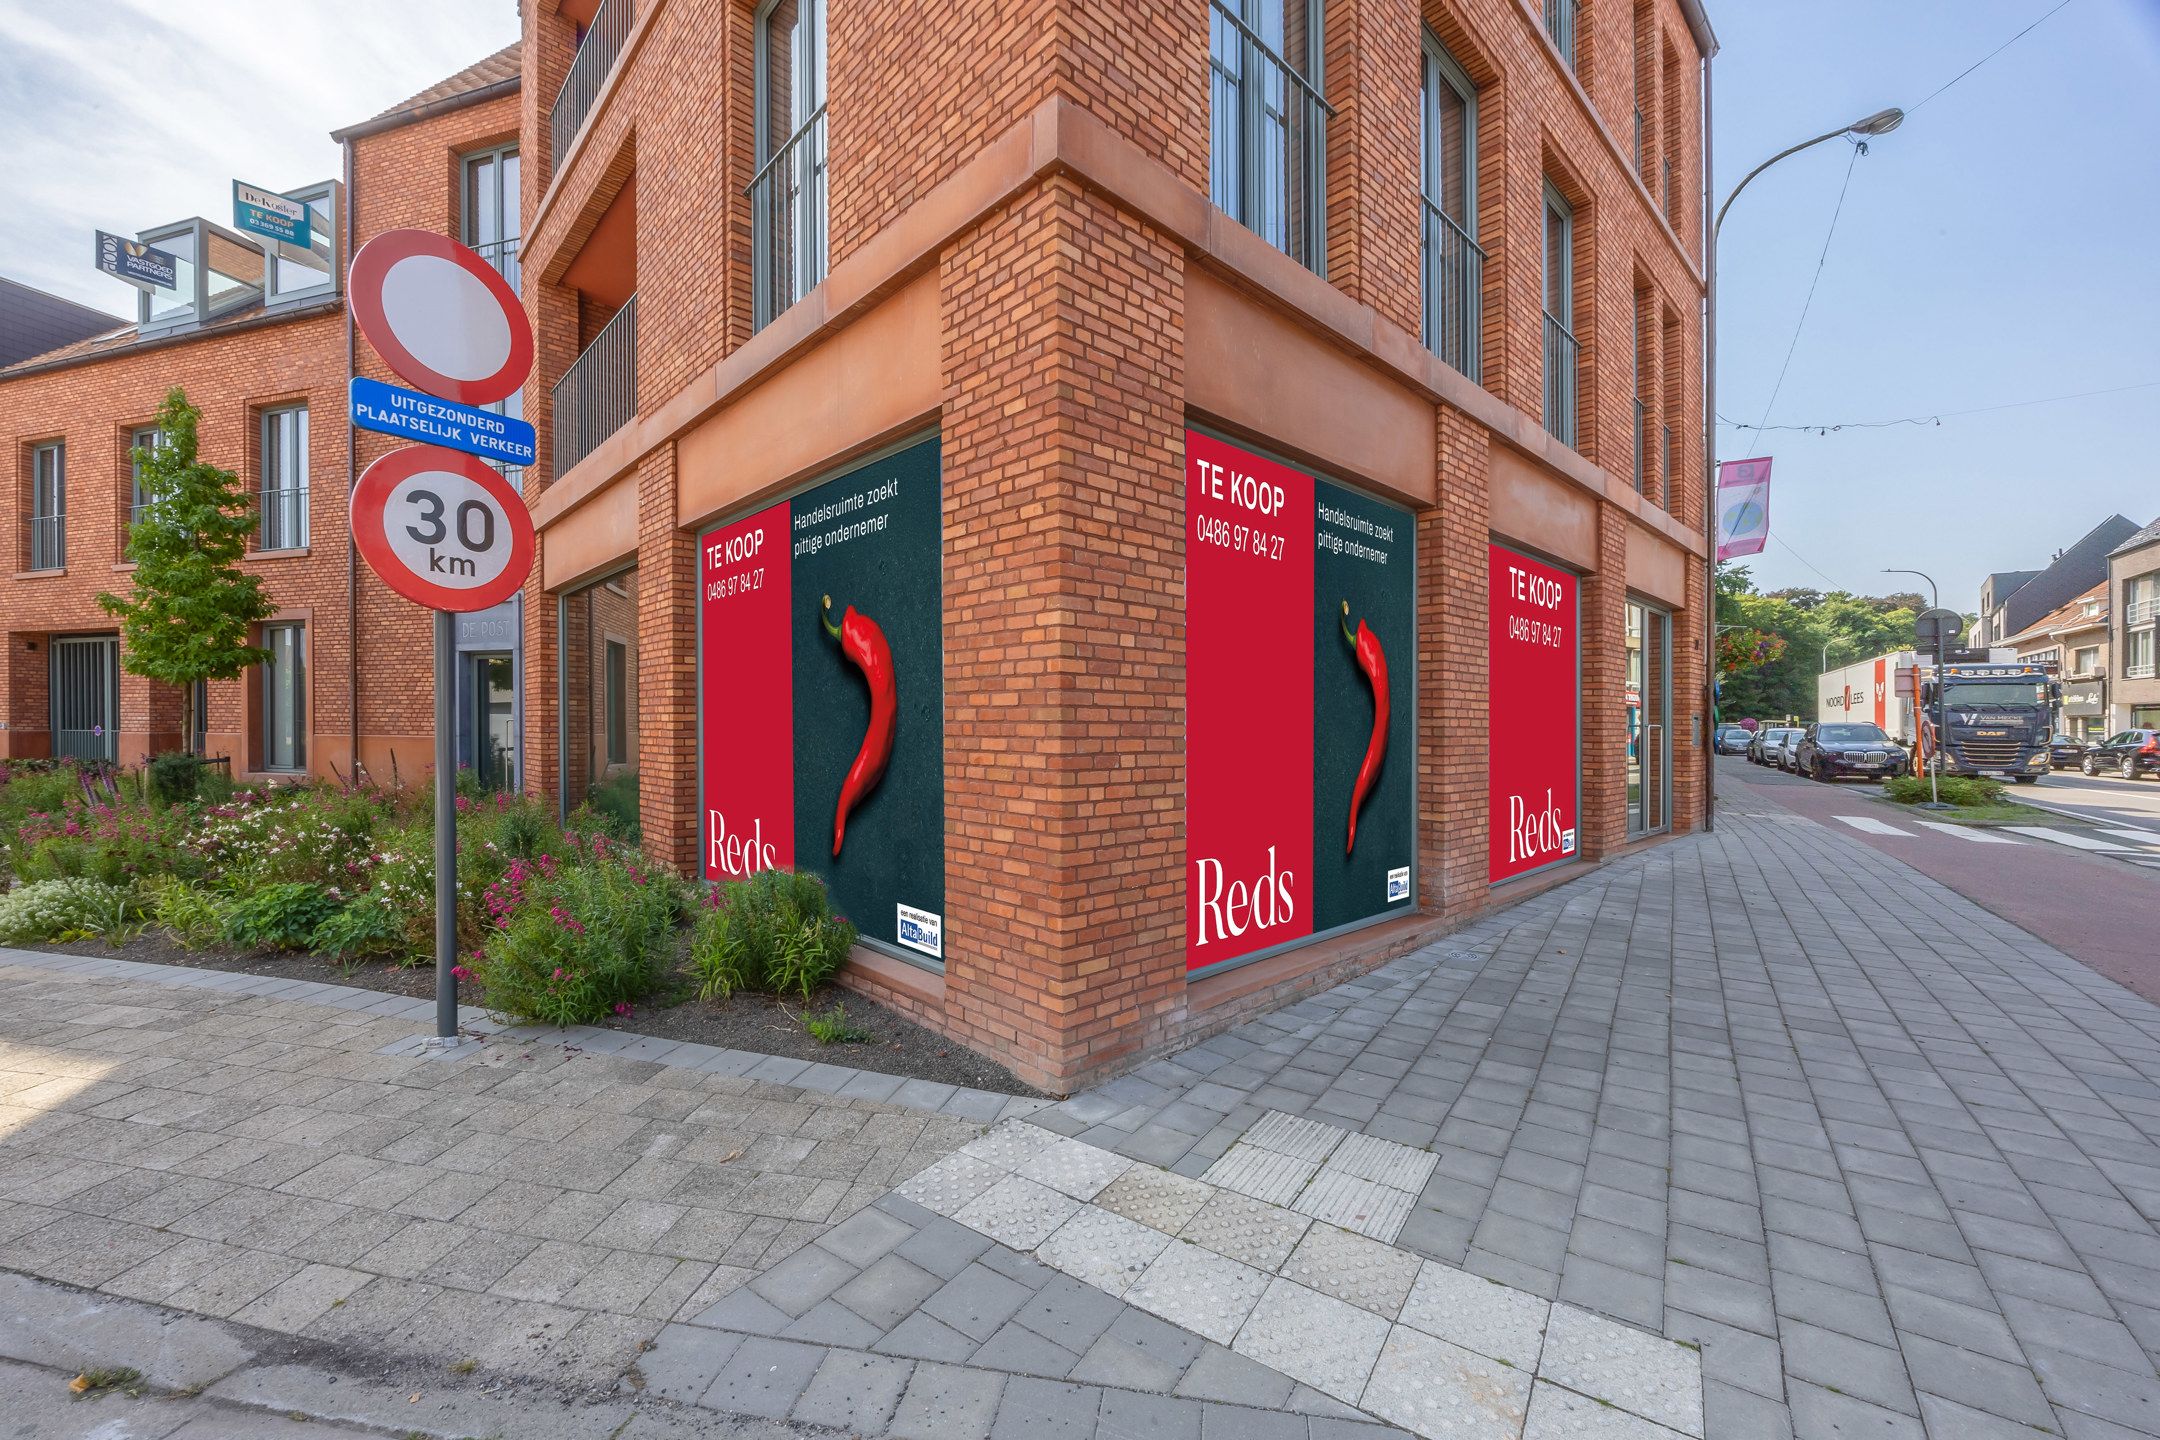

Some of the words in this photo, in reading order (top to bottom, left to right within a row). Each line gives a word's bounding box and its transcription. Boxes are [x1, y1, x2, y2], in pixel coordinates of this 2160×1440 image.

[250, 209, 263, 219] TE
[266, 213, 294, 228] KOOP
[102, 235, 118, 271] KOOP
[127, 254, 173, 274] VASTGOED
[127, 261, 173, 281] PARTNERS
[356, 403, 462, 441] PLAATSELIJK
[470, 432, 532, 458] VERKEER
[391, 393, 505, 435] UITGEZONDERD
[794, 494, 864, 530] Handelsruimte
[867, 477, 899, 505] zoekt
[1196, 458, 1224, 501] TE
[1231, 471, 1285, 518] KOOP
[405, 489, 495, 553] 30
[794, 534, 823, 559] pittige
[825, 514, 889, 546] ondernemer
[1197, 514, 1230, 548] 0486
[1234, 524, 1249, 552] 97
[1252, 530, 1267, 556] 84
[1270, 535, 1285, 561] 27
[1318, 501, 1373, 536] Handelsruimte
[1375, 525, 1394, 543] zoekt
[429, 547, 476, 577] km
[707, 543, 722, 570] TE
[725, 528, 764, 565] KOOP
[1317, 530, 1343, 555] pittige
[1344, 541, 1388, 565] ondernemer
[707, 581, 726, 601] 0486
[728, 574, 739, 596] 97
[740, 571, 751, 591] 84
[753, 567, 765, 589] 27
[1509, 566, 1526, 601] TE
[1529, 573, 1562, 611] KOOP
[462, 622, 477, 638] DE
[481, 620, 510, 637] POST
[1509, 615, 1529, 642] 0486
[1531, 620, 1540, 644] 97
[1542, 623, 1551, 647] 84
[1553, 626, 1562, 648] 27
[709, 809, 776, 879] Reds
[1509, 787, 1561, 863] Reds
[1195, 845, 1294, 947] Reds
[909, 912, 928, 925] realisatie
[929, 918, 938, 927] van
